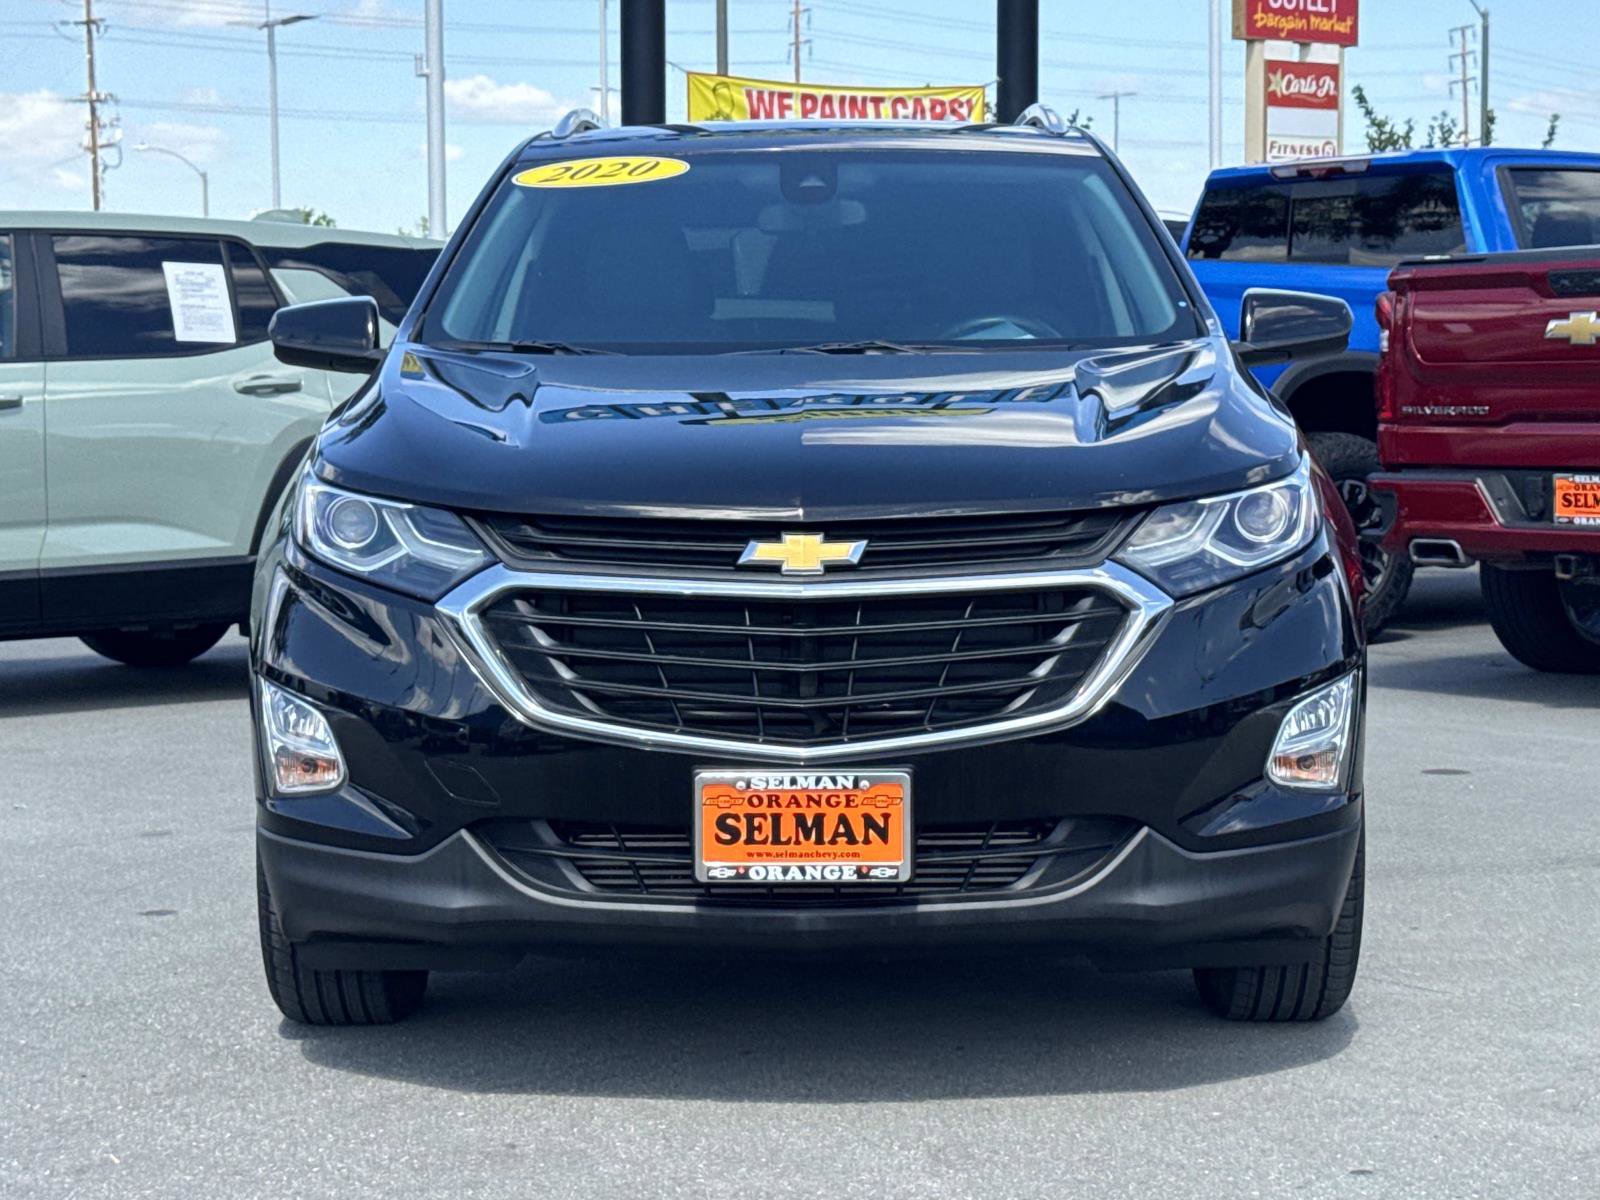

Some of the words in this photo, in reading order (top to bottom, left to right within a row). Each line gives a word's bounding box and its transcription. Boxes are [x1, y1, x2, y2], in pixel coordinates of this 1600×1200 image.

[1253, 2, 1307, 38] bargain
[1310, 14, 1353, 34] market
[1281, 73, 1318, 96] Carl's
[745, 88, 793, 119] WE
[800, 92, 886, 119] PAINT
[1269, 140, 1320, 156] FITNESS
[538, 160, 660, 183] 2020
[749, 776, 855, 790] SELMAN
[747, 794, 860, 809] ORANGE
[714, 812, 892, 846] SELMAN
[746, 850, 861, 860] www.selmanchevy.com
[749, 866, 857, 881] ORANGE
